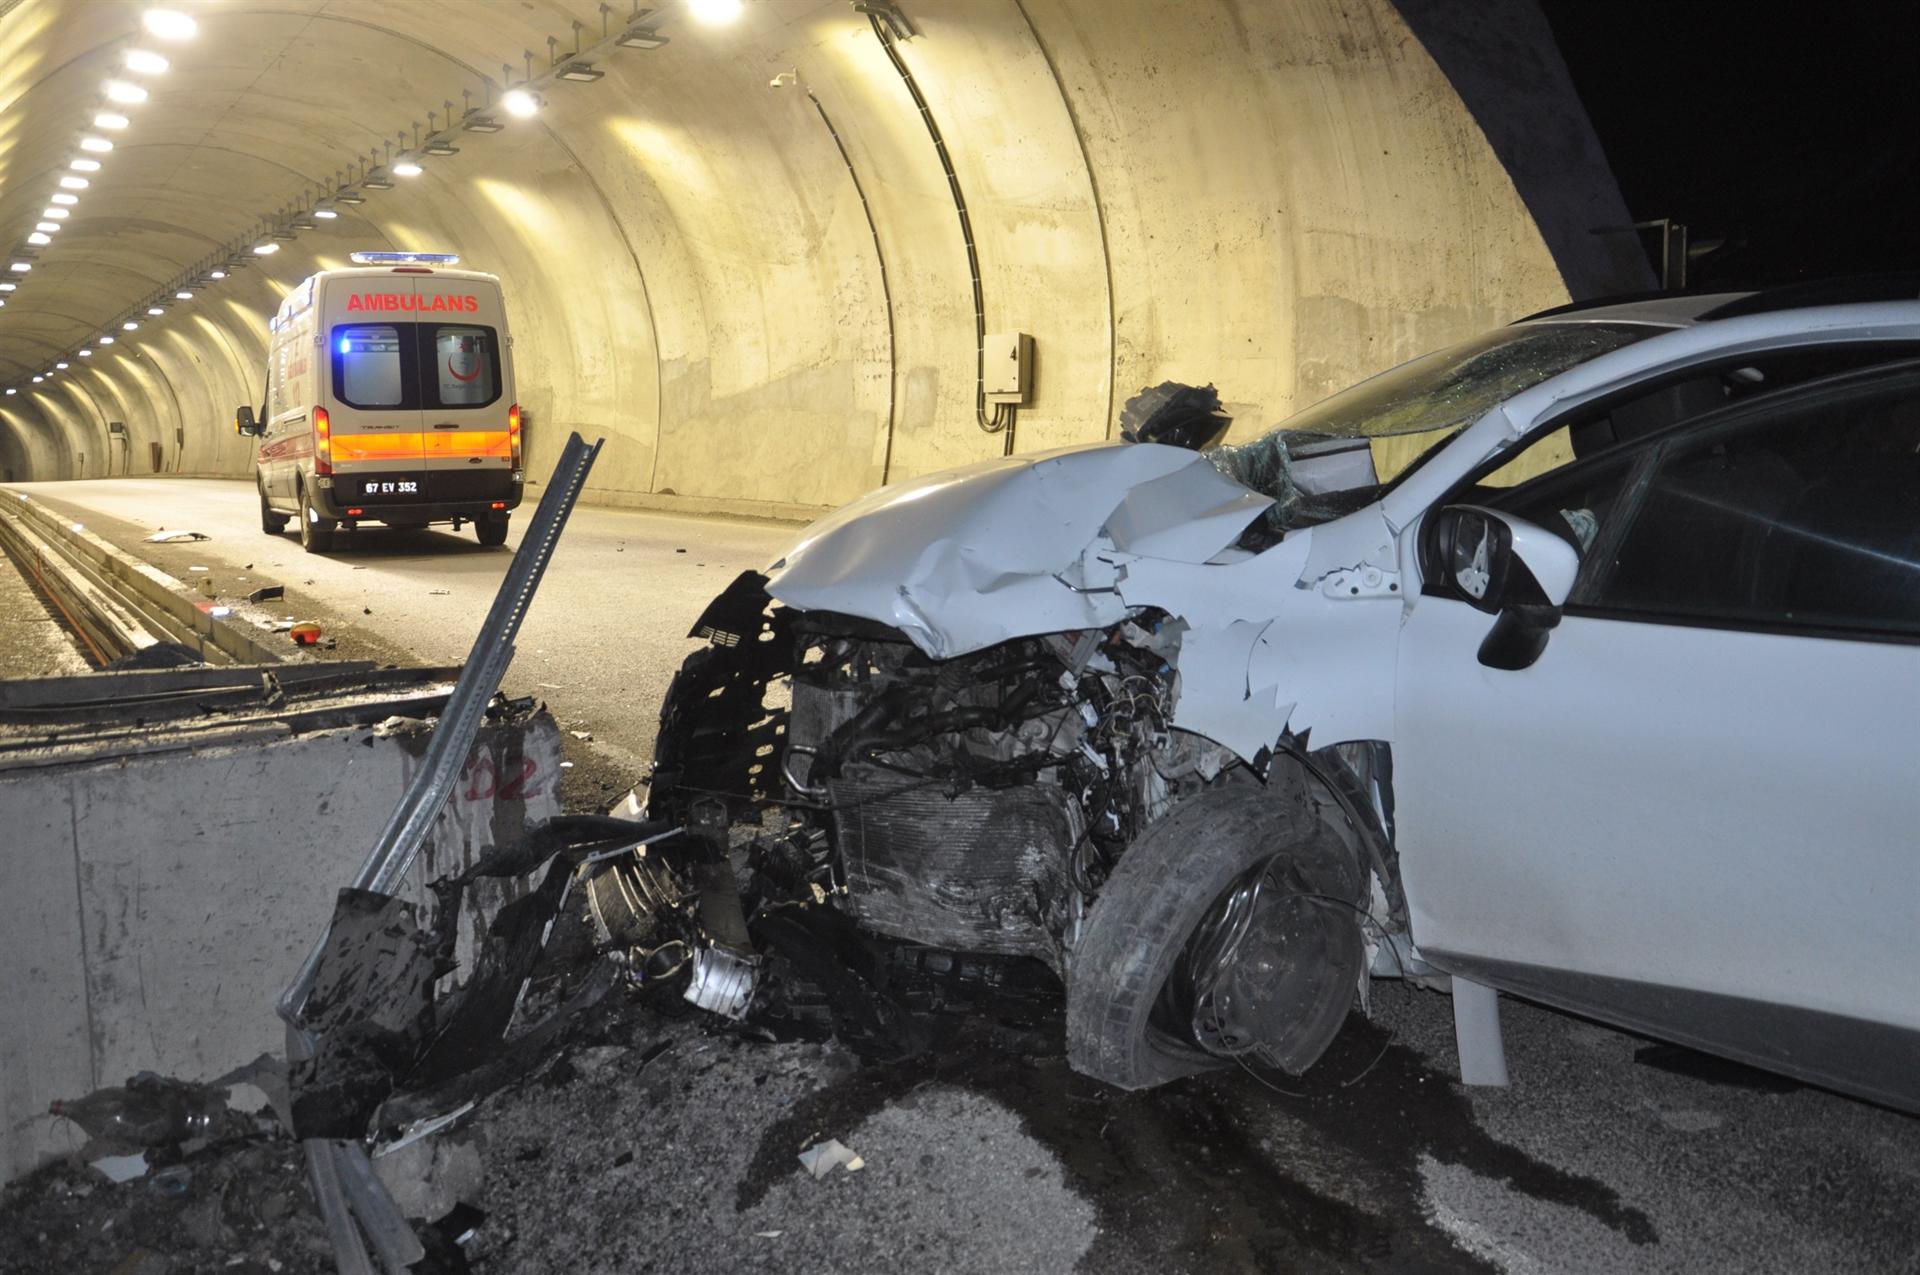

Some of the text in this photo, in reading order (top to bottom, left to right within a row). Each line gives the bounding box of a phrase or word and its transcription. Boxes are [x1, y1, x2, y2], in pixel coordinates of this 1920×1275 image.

[347, 294, 478, 312] AMBULANS
[1010, 346, 1017, 361] 4
[365, 482, 417, 493] 67 EV 352
